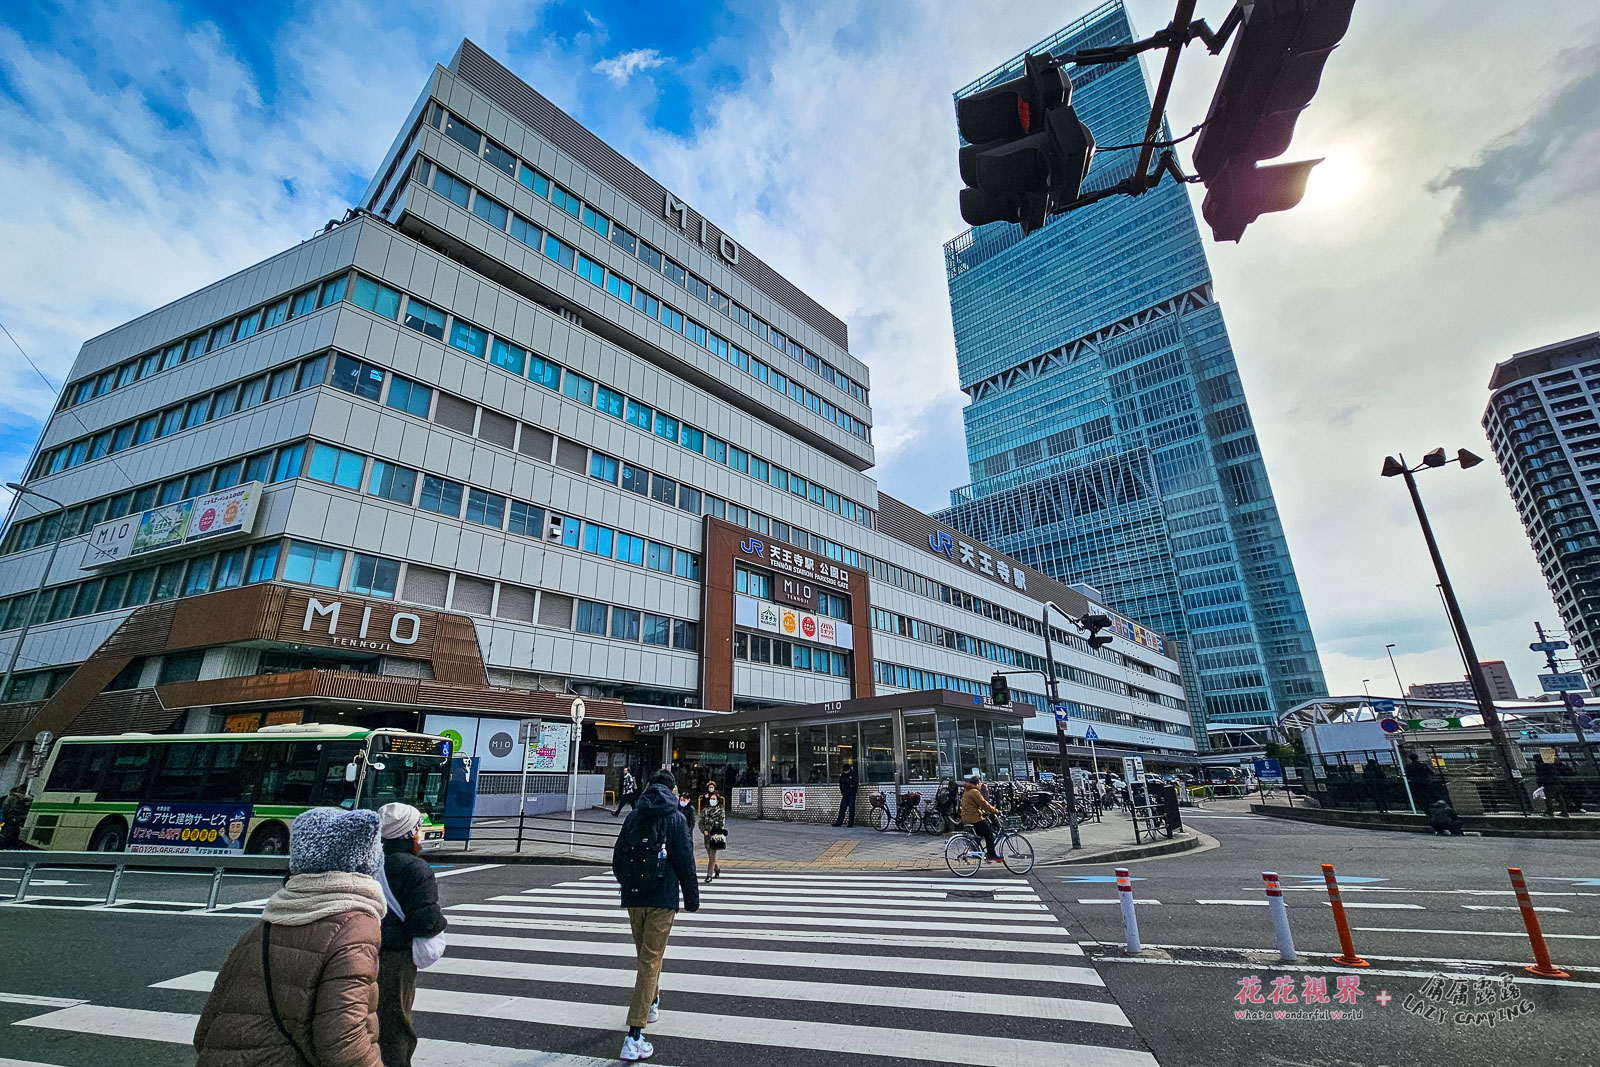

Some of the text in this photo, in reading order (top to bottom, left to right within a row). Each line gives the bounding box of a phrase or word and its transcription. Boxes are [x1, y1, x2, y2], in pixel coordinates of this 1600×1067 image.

[665, 191, 739, 265] MIO
[96, 523, 130, 545] MIO
[741, 538, 849, 583] JR 天王寺駅 公園口
[928, 530, 1027, 591] JR 天王寺駅
[793, 566, 814, 578] STATION
[814, 573, 837, 586] PARKSIDE
[837, 581, 849, 590] GATE
[783, 579, 812, 599] MIO
[786, 593, 810, 604] TENNOJI
[302, 598, 420, 645] MIO
[333, 637, 390, 651] TENNOJI
[825, 701, 842, 711] MIO
[491, 740, 511, 748] MIO
[728, 741, 746, 749] MIO
[152, 812, 227, 826] アサヒ建物サービス
[132, 828, 182, 841] リフォーム専門
